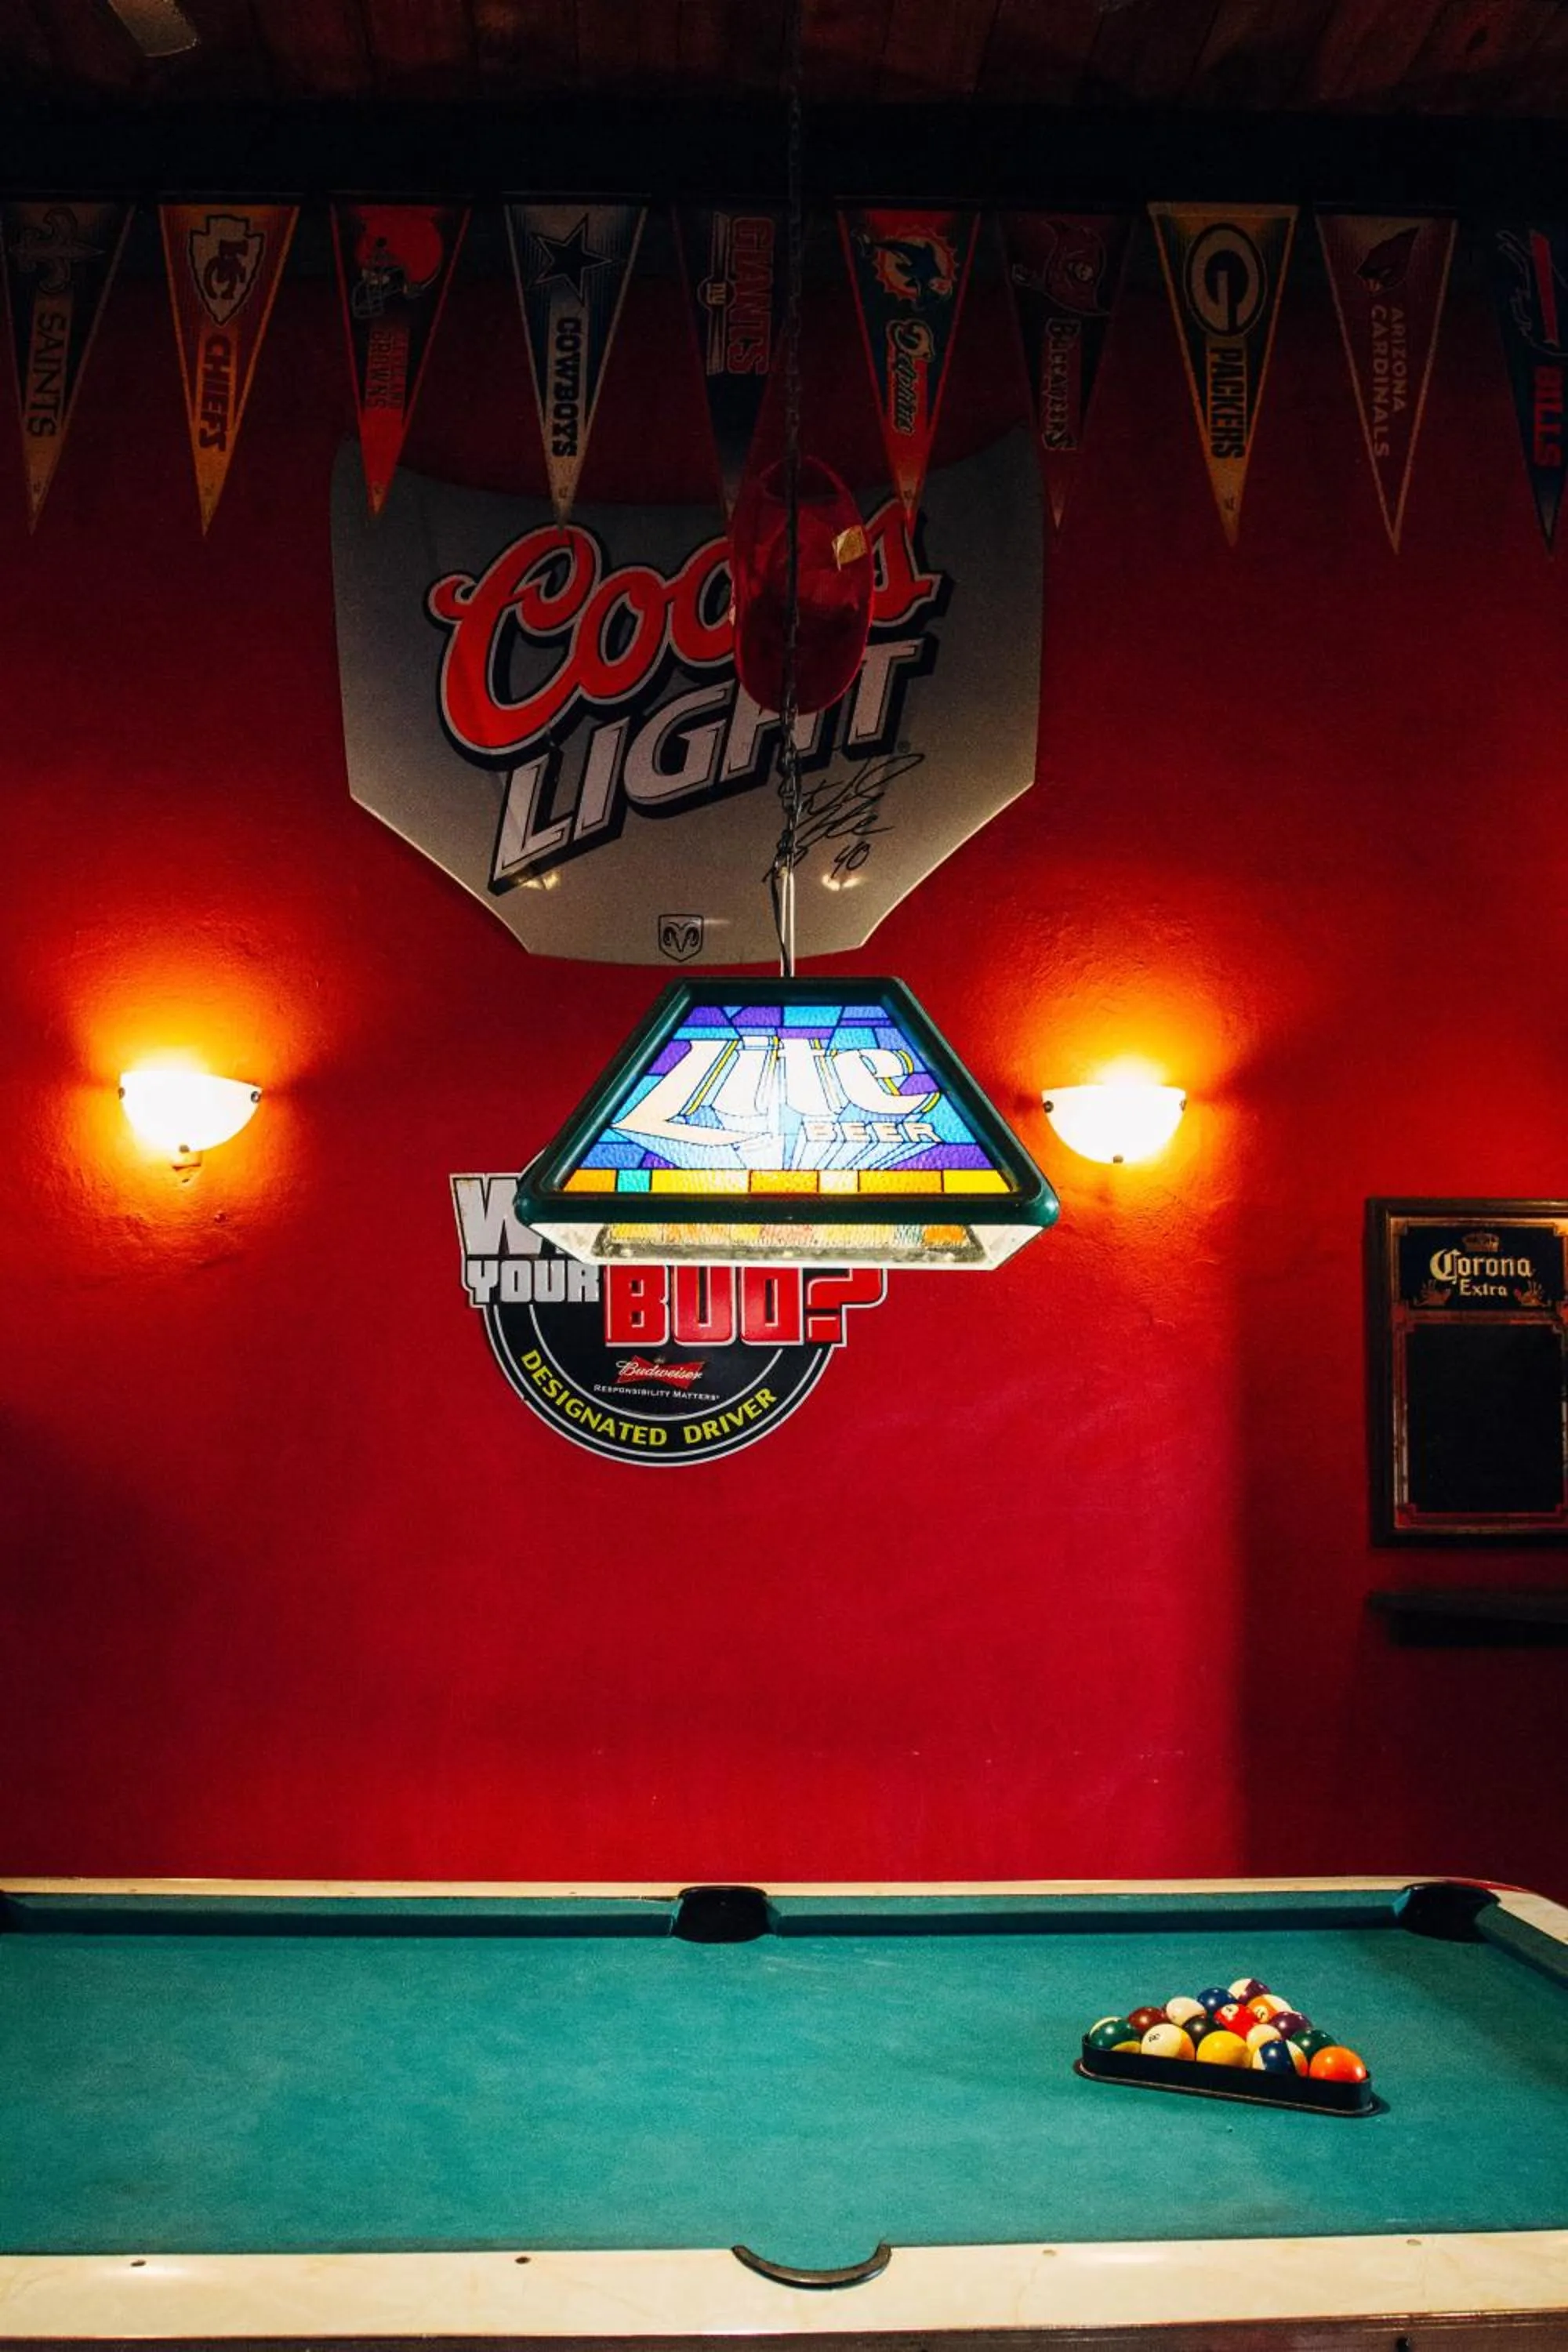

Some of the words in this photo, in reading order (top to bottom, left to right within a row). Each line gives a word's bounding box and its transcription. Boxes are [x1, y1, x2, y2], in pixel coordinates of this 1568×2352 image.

[725, 216, 776, 376] GIANTS
[27, 314, 66, 437] SAINTS
[200, 335, 233, 452] CHIEFS
[552, 318, 581, 457] COWBOYS
[1211, 349, 1244, 458] PACKERS
[1370, 303, 1390, 458] CARDINALS
[1387, 307, 1409, 413] ARIZONA
[1532, 365, 1564, 468] BILLS
[610, 1035, 941, 1146] Lite
[801, 1120, 942, 1144] BEER
[466, 1259, 601, 1303] YOUR
[604, 1264, 888, 1347] BUD?
[1429, 1247, 1534, 1285] Corona
[1459, 1278, 1508, 1297] Extra
[520, 1347, 669, 1446] DESIGNATED
[683, 1386, 779, 1446] DRIVER
[615, 1359, 703, 1381] Budweiser
